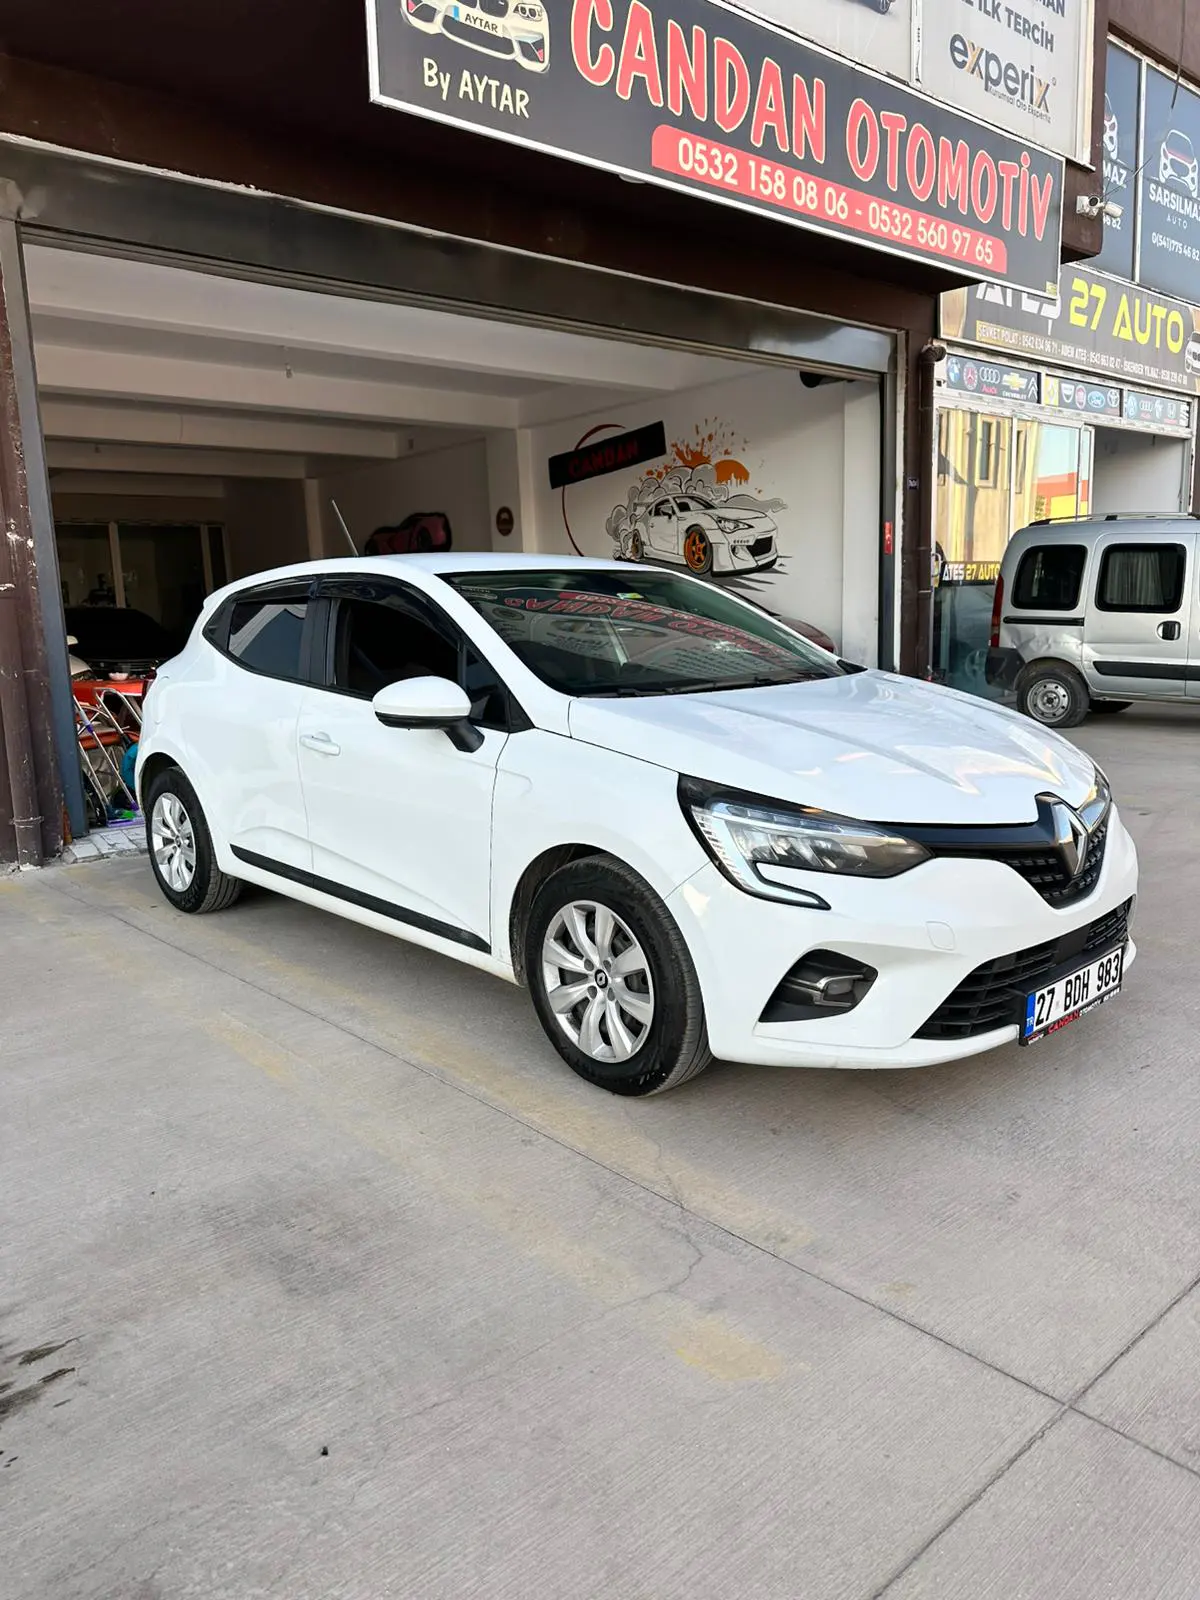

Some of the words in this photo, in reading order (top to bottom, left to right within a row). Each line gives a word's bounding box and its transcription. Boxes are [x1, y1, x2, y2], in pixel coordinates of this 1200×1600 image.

[464, 12, 498, 33] AYTAR
[1005, 6, 1054, 53] TERCİH
[423, 57, 450, 101] By
[458, 70, 530, 118] AYTAR
[950, 33, 1050, 113] experix
[571, 0, 826, 163] CANDAN
[846, 98, 1053, 242] OTOMOTİV
[678, 137, 738, 186] 0532
[748, 157, 786, 201] 158
[793, 175, 818, 211] 08
[824, 187, 849, 220] 06
[868, 202, 912, 242] 0532
[916, 220, 947, 250] 560
[951, 230, 971, 256] 97
[975, 239, 994, 265] 65
[1149, 182, 1200, 221] SARSILMA
[1166, 213, 1188, 229] AUTO
[1069, 277, 1107, 330] 27
[1112, 293, 1184, 354] AUTO
[567, 440, 639, 479] CANDAN
[965, 564, 977, 581] 27
[1026, 1016, 1034, 1027] TR
[1035, 987, 1056, 1027] 27
[1063, 969, 1090, 1012] BDH
[1097, 953, 1120, 992] 983
